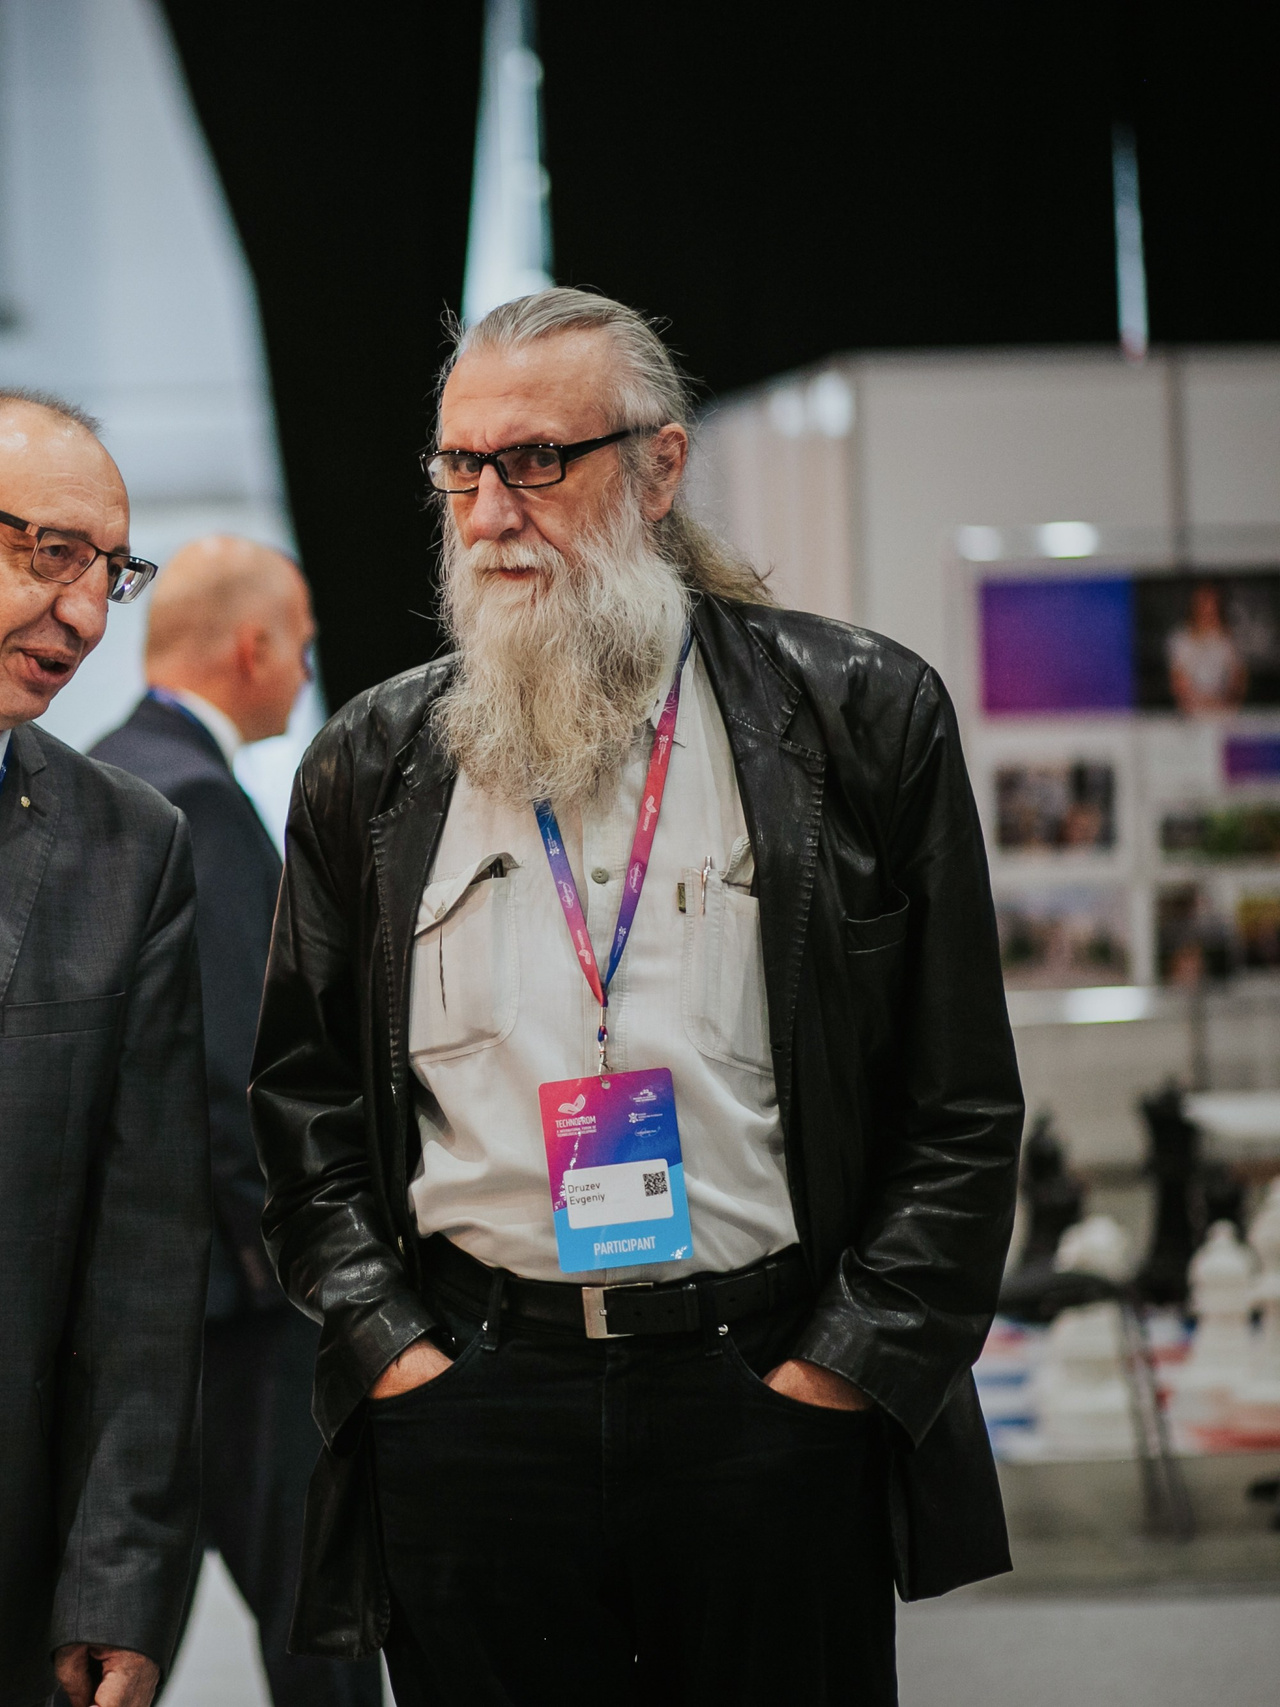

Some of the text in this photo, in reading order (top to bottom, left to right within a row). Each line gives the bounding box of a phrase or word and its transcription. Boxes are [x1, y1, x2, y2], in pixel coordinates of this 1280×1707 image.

[555, 1115, 597, 1128] TECHNOPROM
[568, 1182, 601, 1194] Druzev
[570, 1193, 606, 1206] Evgeniy
[593, 1236, 656, 1256] PARTICIPANT
